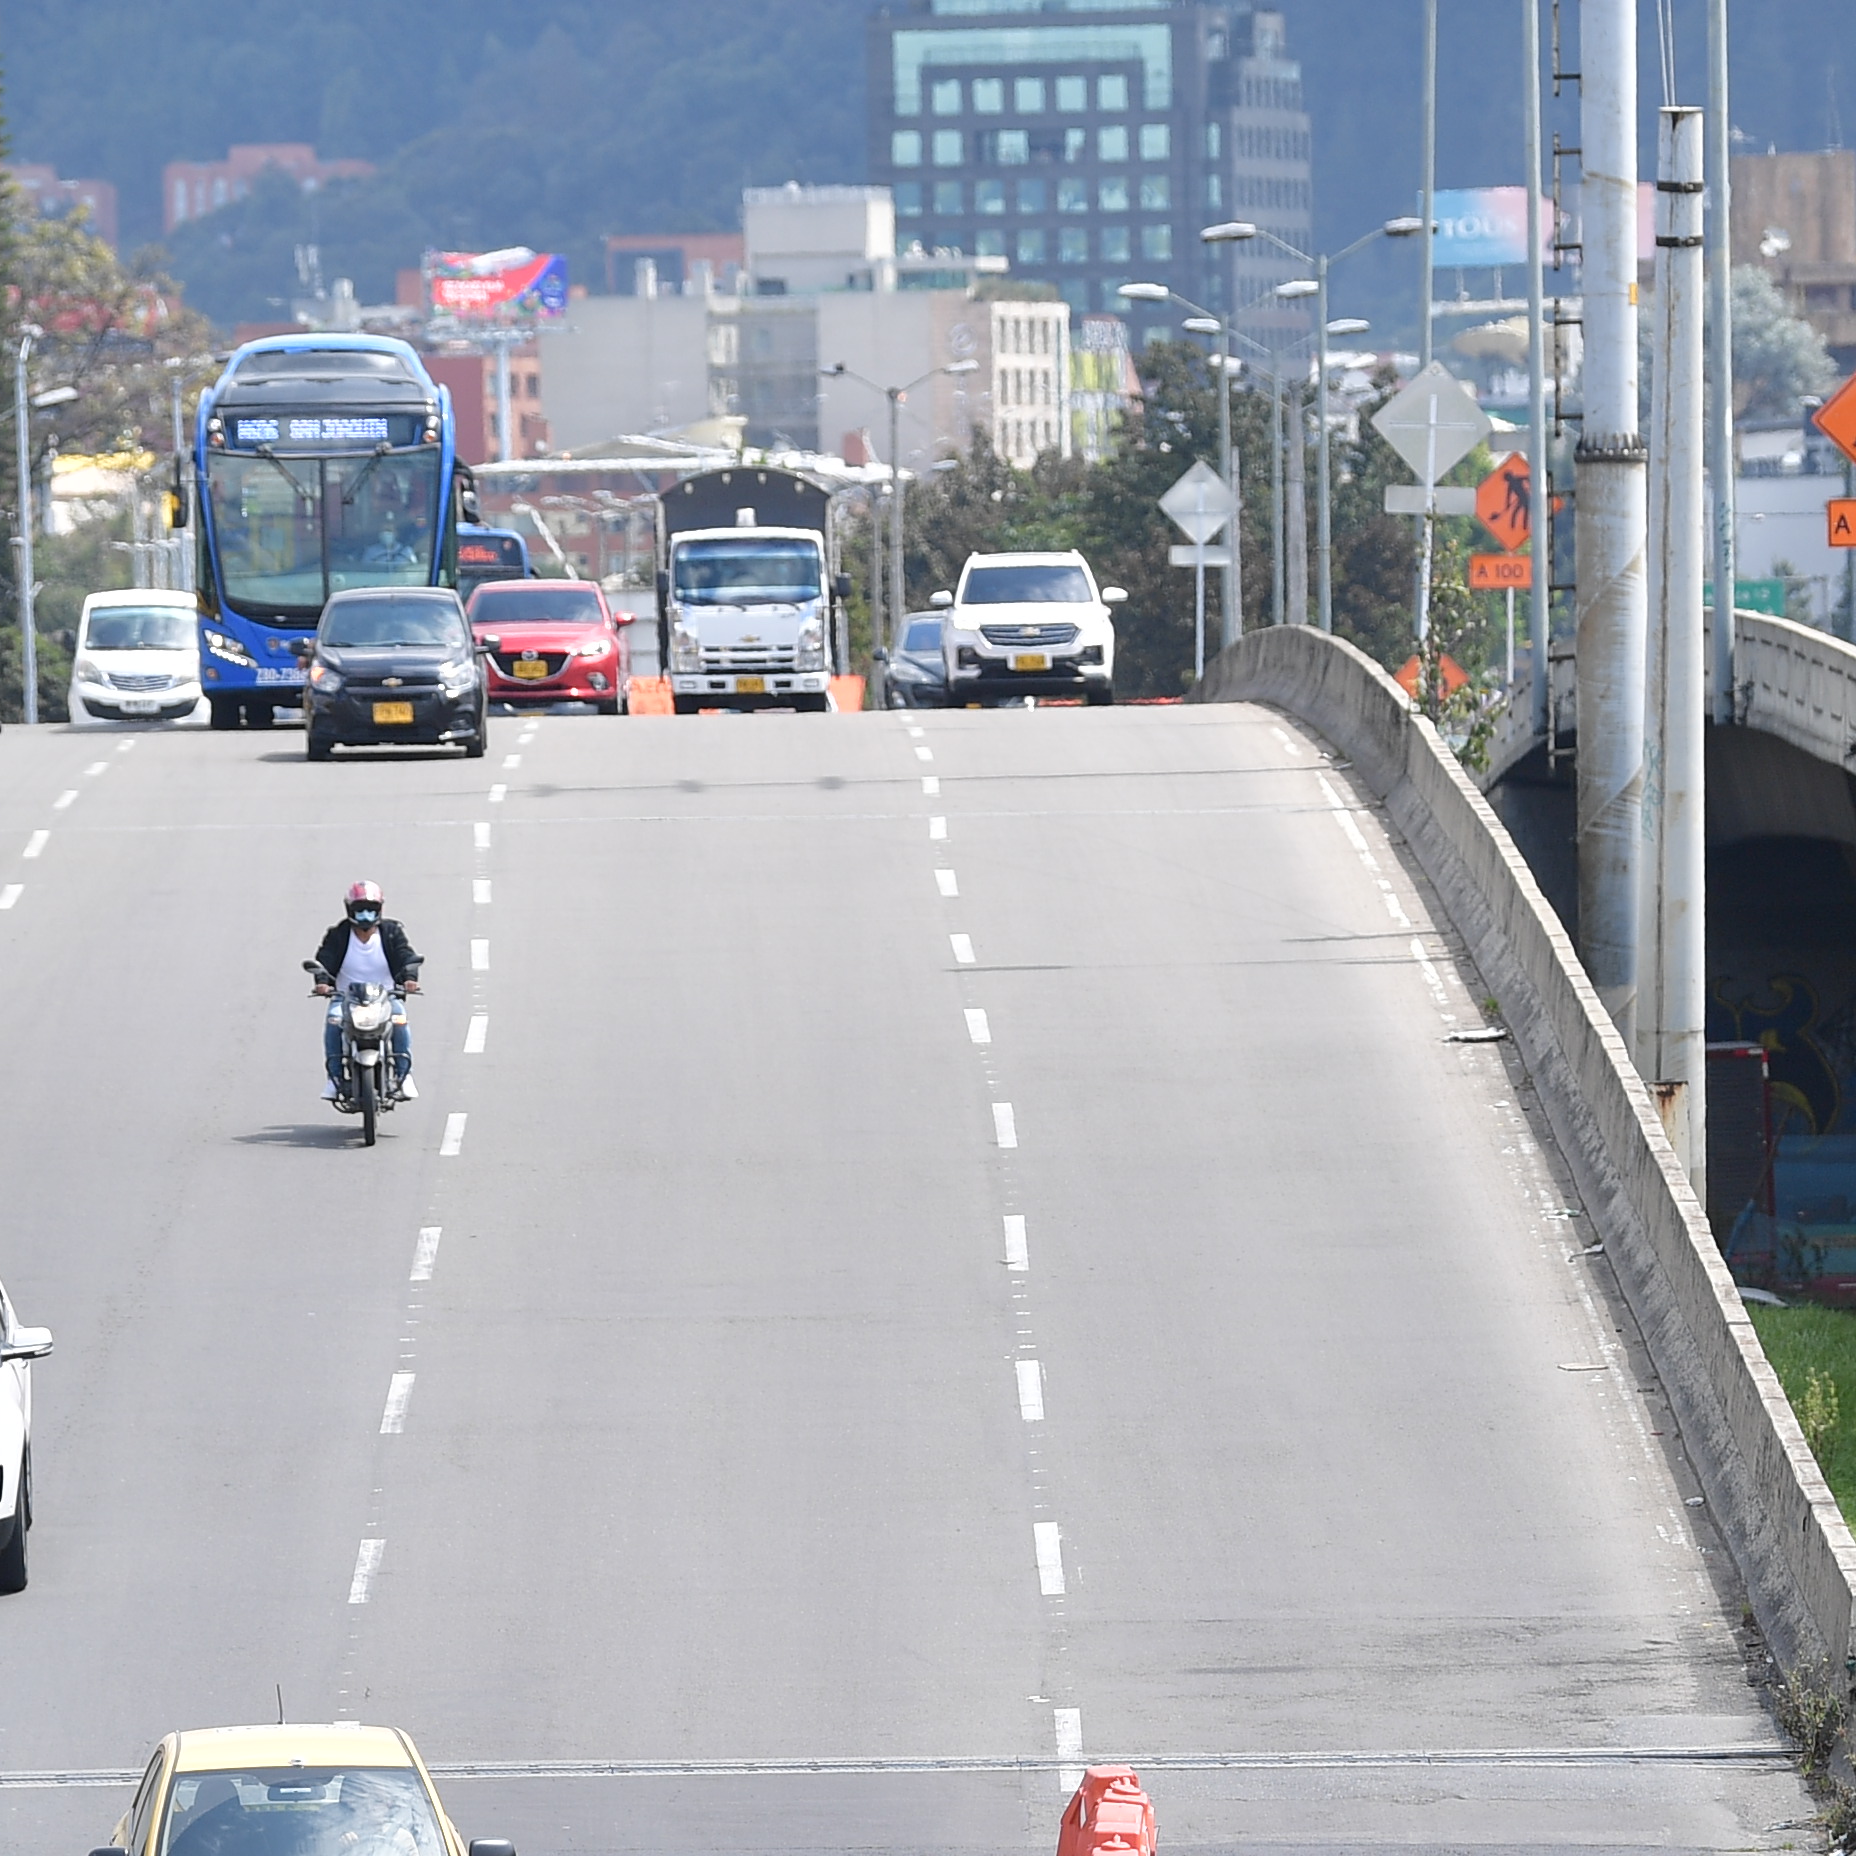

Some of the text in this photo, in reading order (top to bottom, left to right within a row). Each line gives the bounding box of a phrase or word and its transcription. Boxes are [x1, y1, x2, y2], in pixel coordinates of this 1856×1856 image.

[1834, 514, 1851, 534] A
[1477, 563, 1524, 578] A 100
